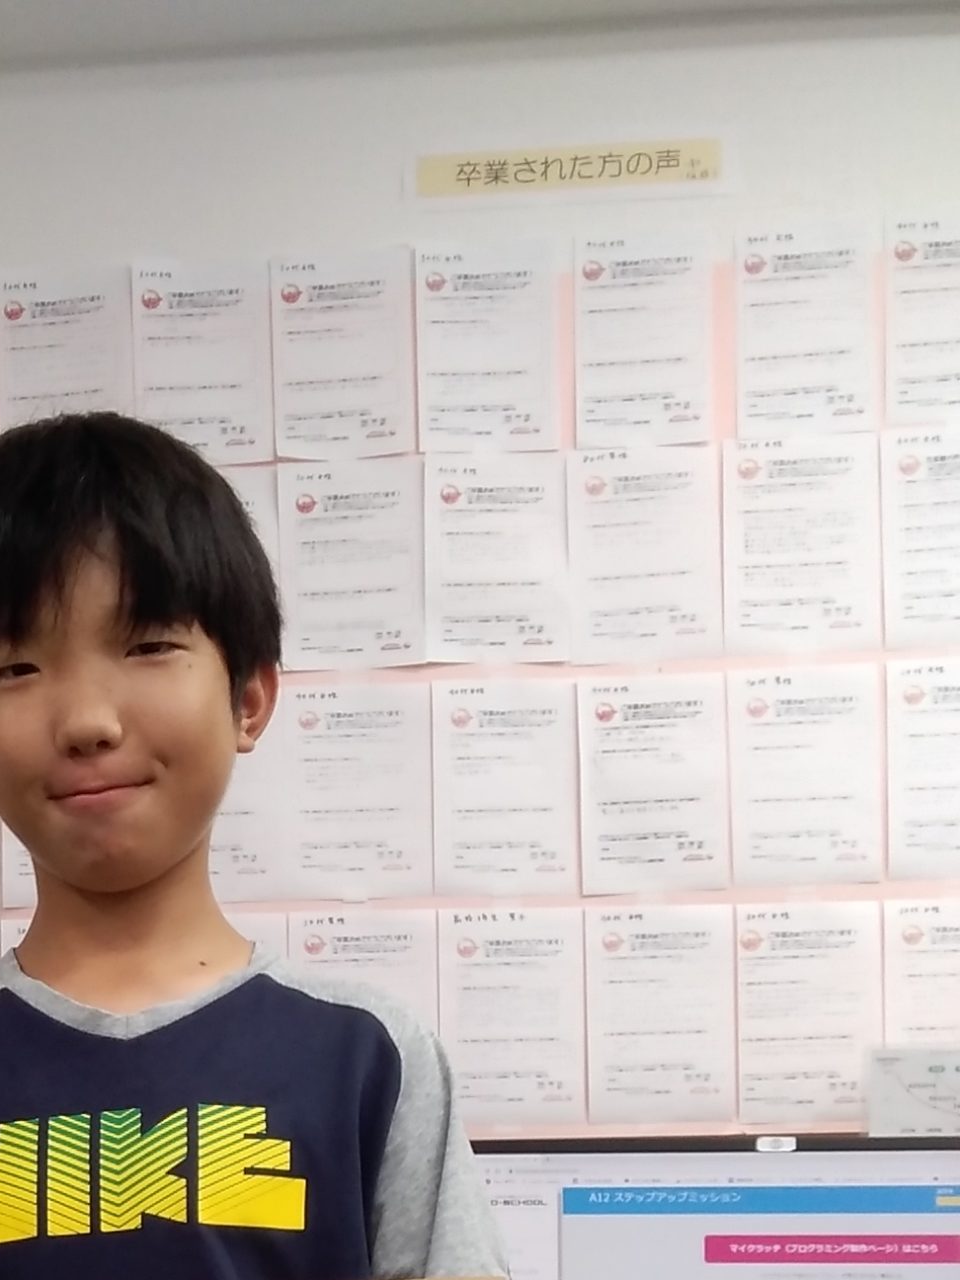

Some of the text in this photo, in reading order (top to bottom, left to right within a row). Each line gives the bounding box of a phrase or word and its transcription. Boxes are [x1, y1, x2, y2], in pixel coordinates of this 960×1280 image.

[455, 149, 682, 187] 卒業された方の声
[589, 1190, 742, 1205] A12 ステップアップミッション
